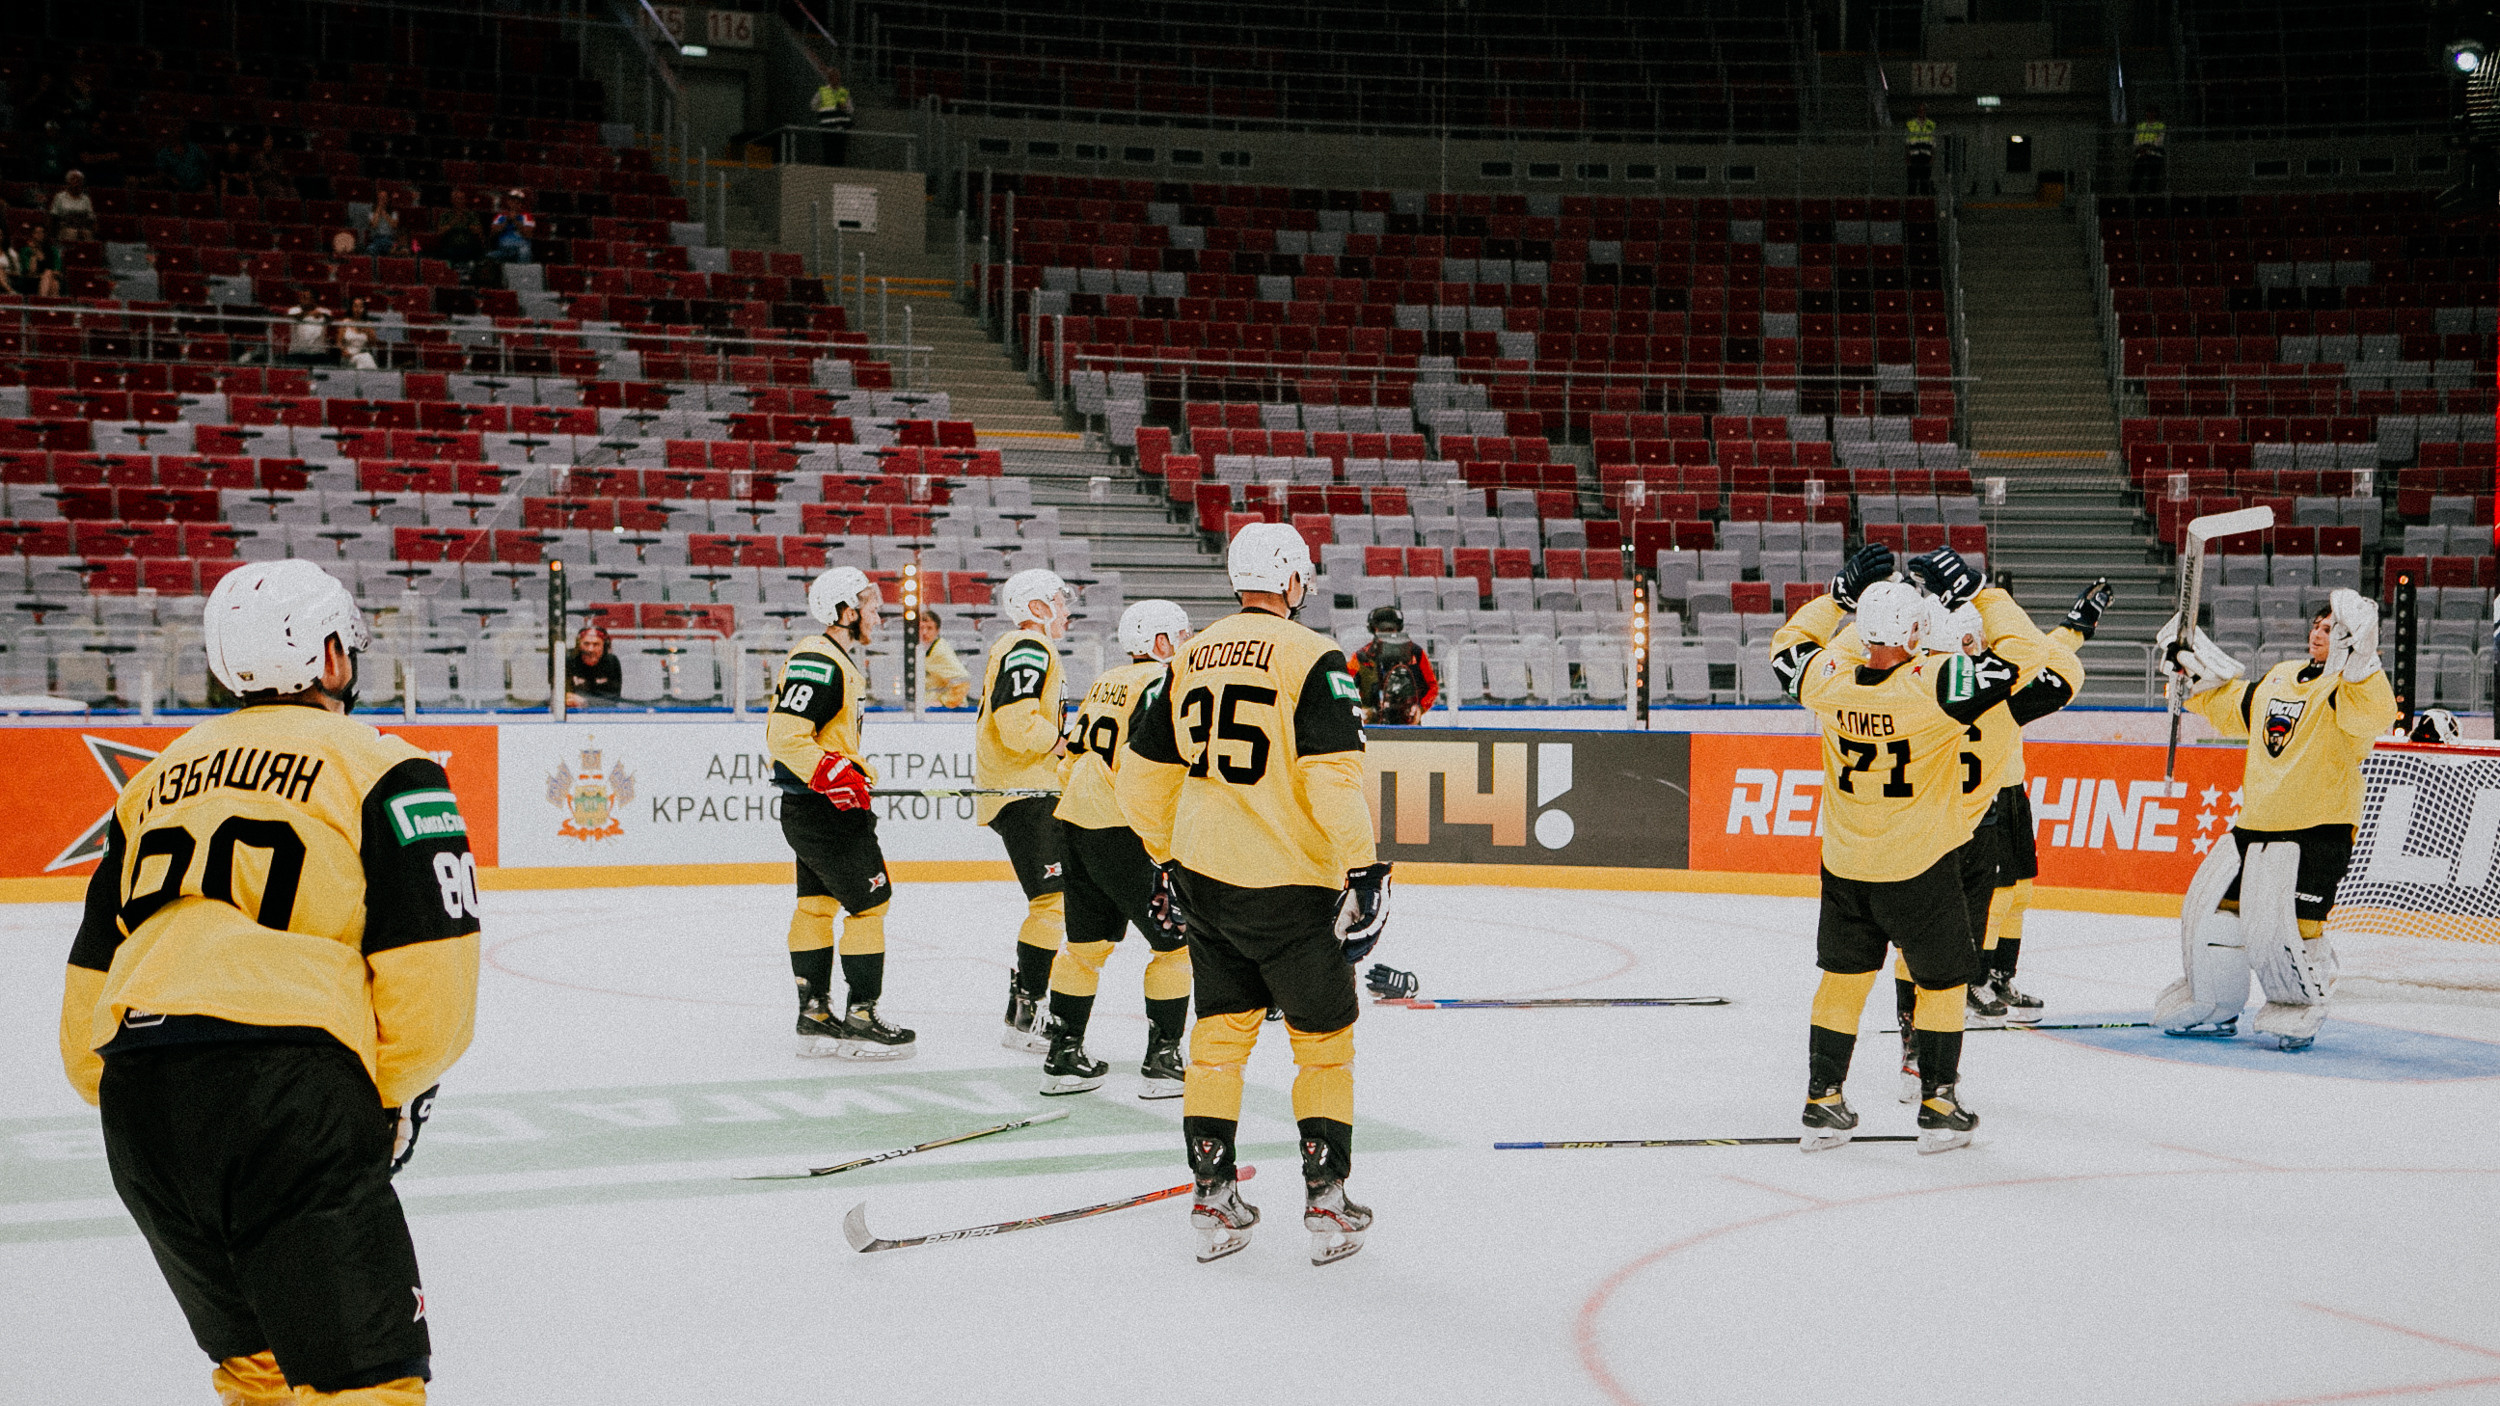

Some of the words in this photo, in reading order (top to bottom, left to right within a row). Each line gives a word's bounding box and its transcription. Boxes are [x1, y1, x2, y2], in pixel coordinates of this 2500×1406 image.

[709, 12, 751, 40] 116
[1914, 62, 1953, 88] 116
[2029, 62, 2068, 88] 117
[1011, 668, 1040, 697] 17
[780, 684, 814, 713] 18
[1180, 684, 1278, 786] 35
[1836, 709, 1896, 737] АЛИЕВ
[1837, 735, 1914, 798] 71
[1725, 768, 1825, 837] RE
[2024, 776, 2189, 853] HINE
[433, 851, 480, 919] 80
[922, 1226, 1000, 1246] BAUER
